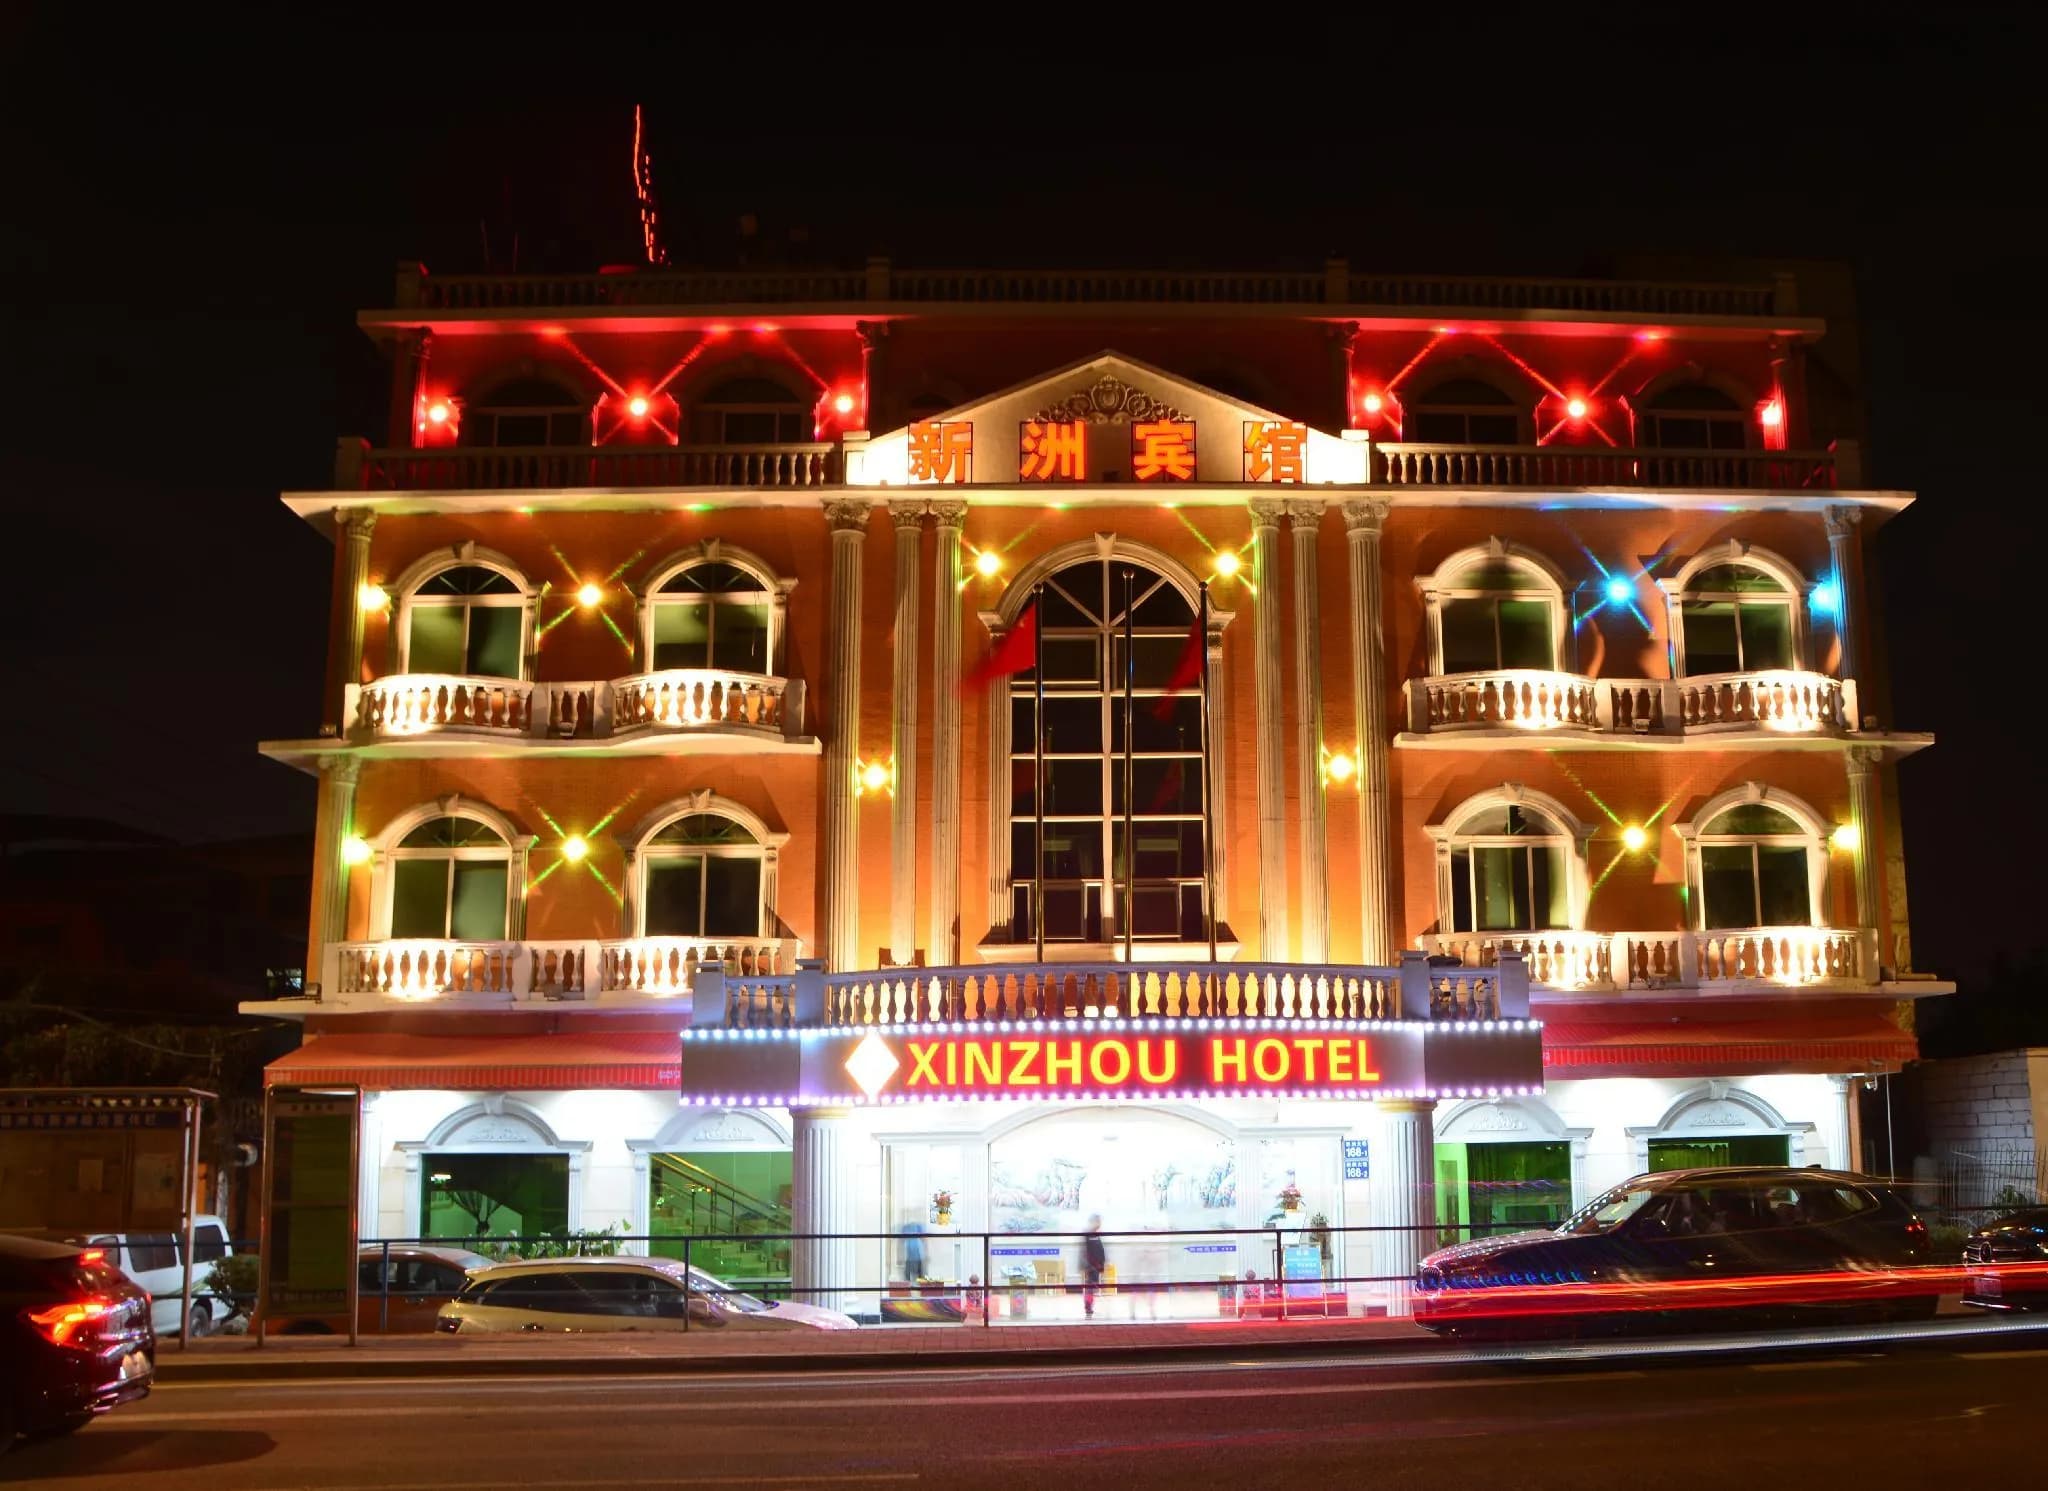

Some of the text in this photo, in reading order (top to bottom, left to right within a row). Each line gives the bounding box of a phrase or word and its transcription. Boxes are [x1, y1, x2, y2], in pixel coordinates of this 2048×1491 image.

[909, 419, 1307, 482] 新洲宾馆
[906, 1037, 1380, 1086] XINZHOU HOTEL
